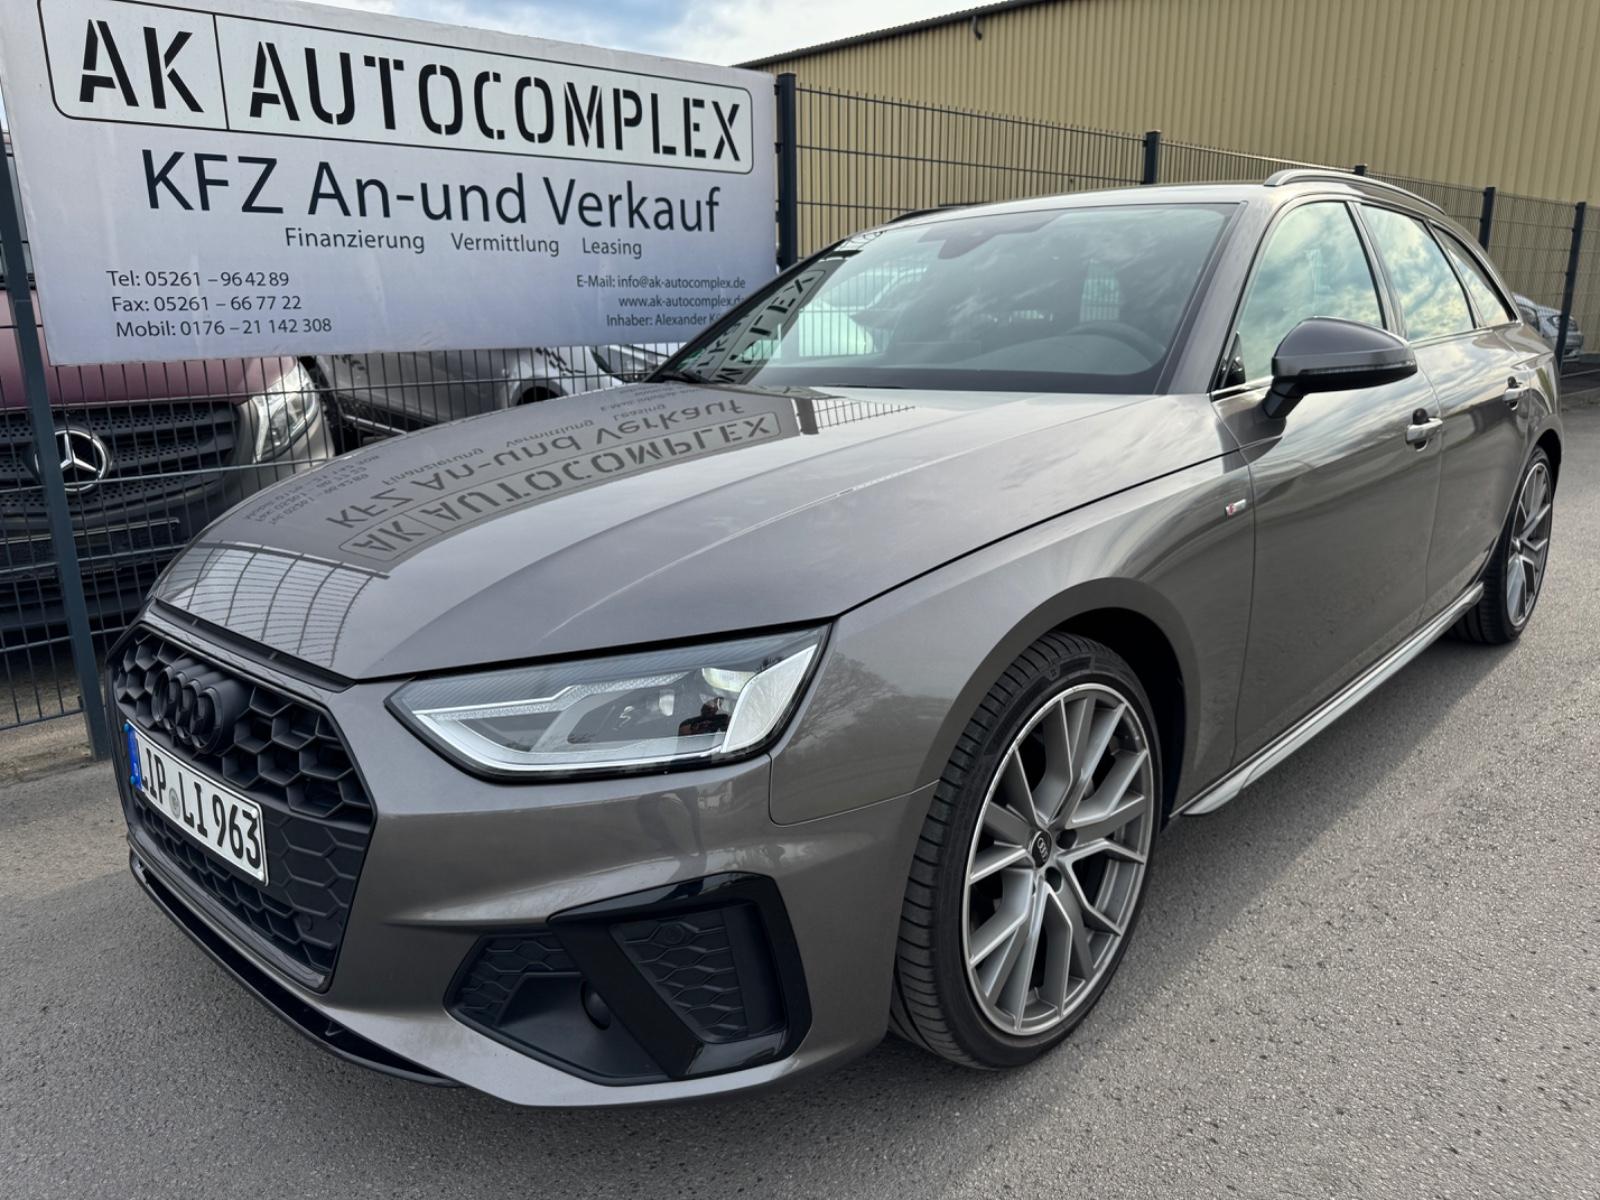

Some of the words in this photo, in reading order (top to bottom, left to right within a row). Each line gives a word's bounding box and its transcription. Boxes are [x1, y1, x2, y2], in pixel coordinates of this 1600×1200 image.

[79, 19, 204, 113] AK
[249, 41, 741, 162] AUTOCOMPLEX
[141, 149, 284, 214] KFZ
[307, 161, 527, 224] An-und
[542, 176, 721, 233] Verkauf
[284, 227, 425, 254] Finanzierung
[451, 232, 560, 257] Vermittlung
[581, 237, 643, 259] Leasing
[106, 270, 141, 287] Tel:
[145, 271, 201, 287] 05261
[576, 274, 615, 289] E-Mail:
[617, 275, 746, 291] info@ak-autocomplex.de
[111, 296, 150, 312] Fax:
[153, 296, 209, 312] 05261
[618, 295, 744, 309] www.ak-autocomplex.d
[116, 320, 176, 337] Mobil:
[179, 320, 225, 336] 0176
[606, 314, 653, 327] Inhaber:
[655, 313, 707, 326] Alexander
